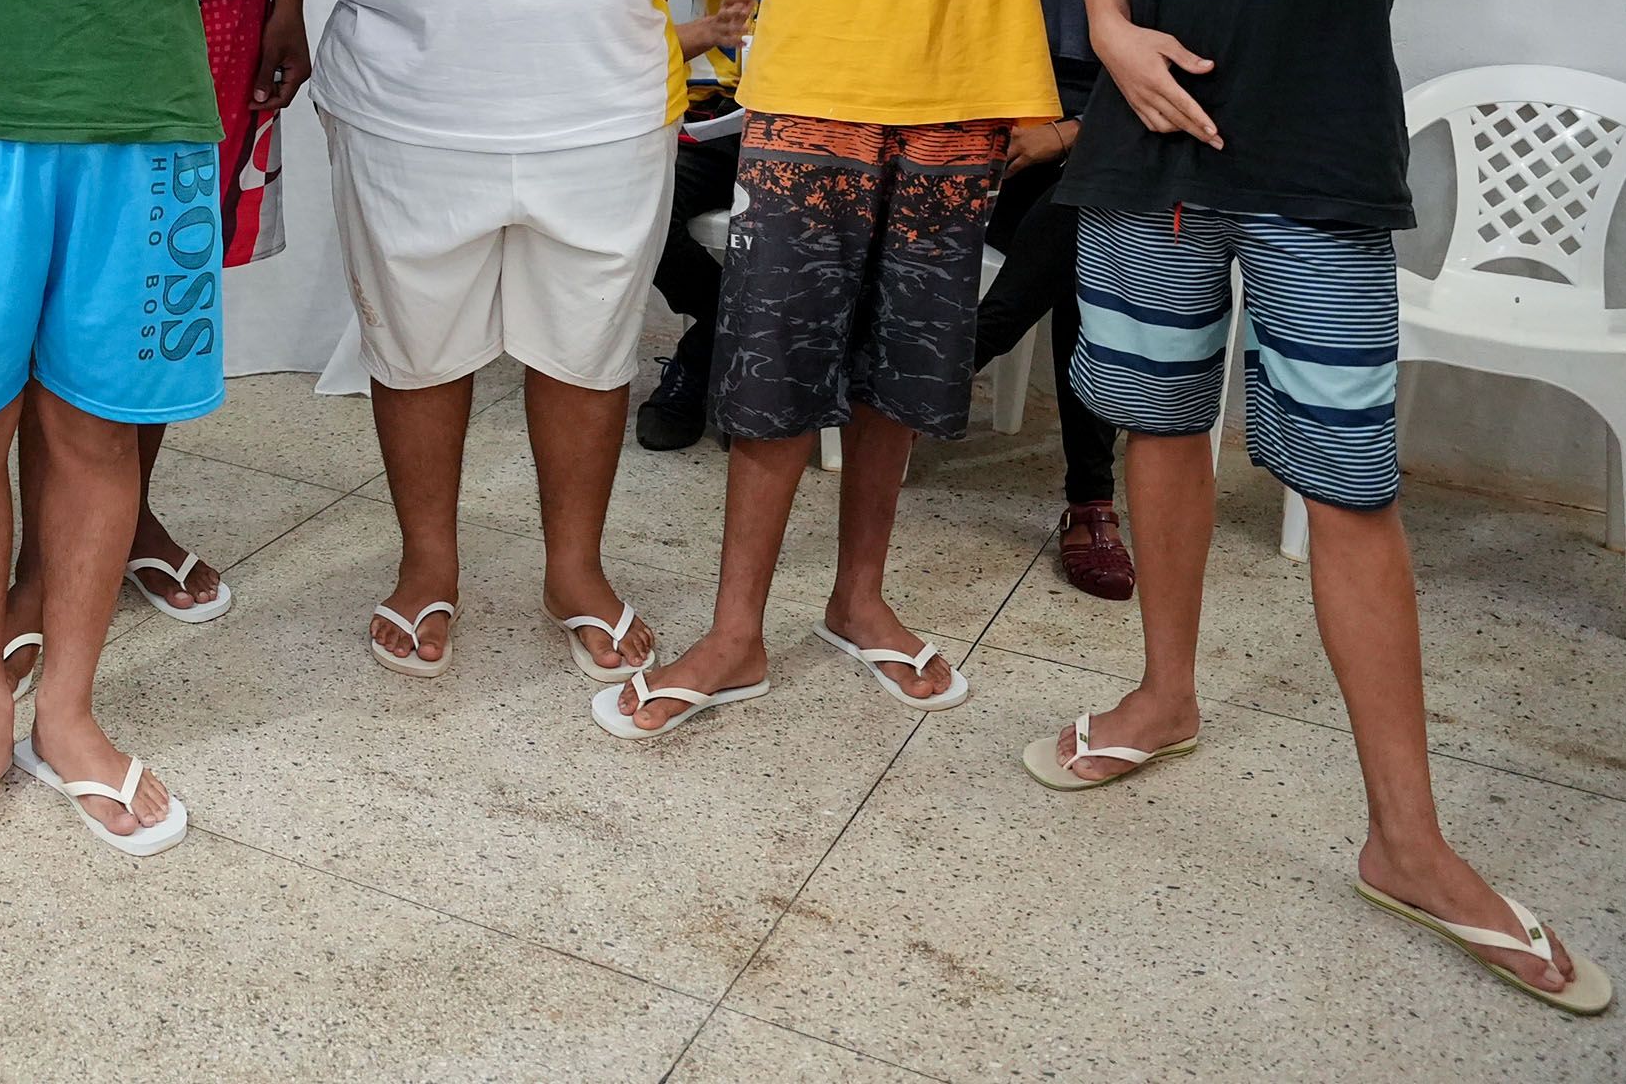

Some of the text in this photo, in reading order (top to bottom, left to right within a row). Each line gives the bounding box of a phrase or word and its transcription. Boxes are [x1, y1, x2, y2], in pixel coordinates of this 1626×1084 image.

[138, 157, 167, 361] HUGO BOSS
[160, 150, 215, 361] BOSS
